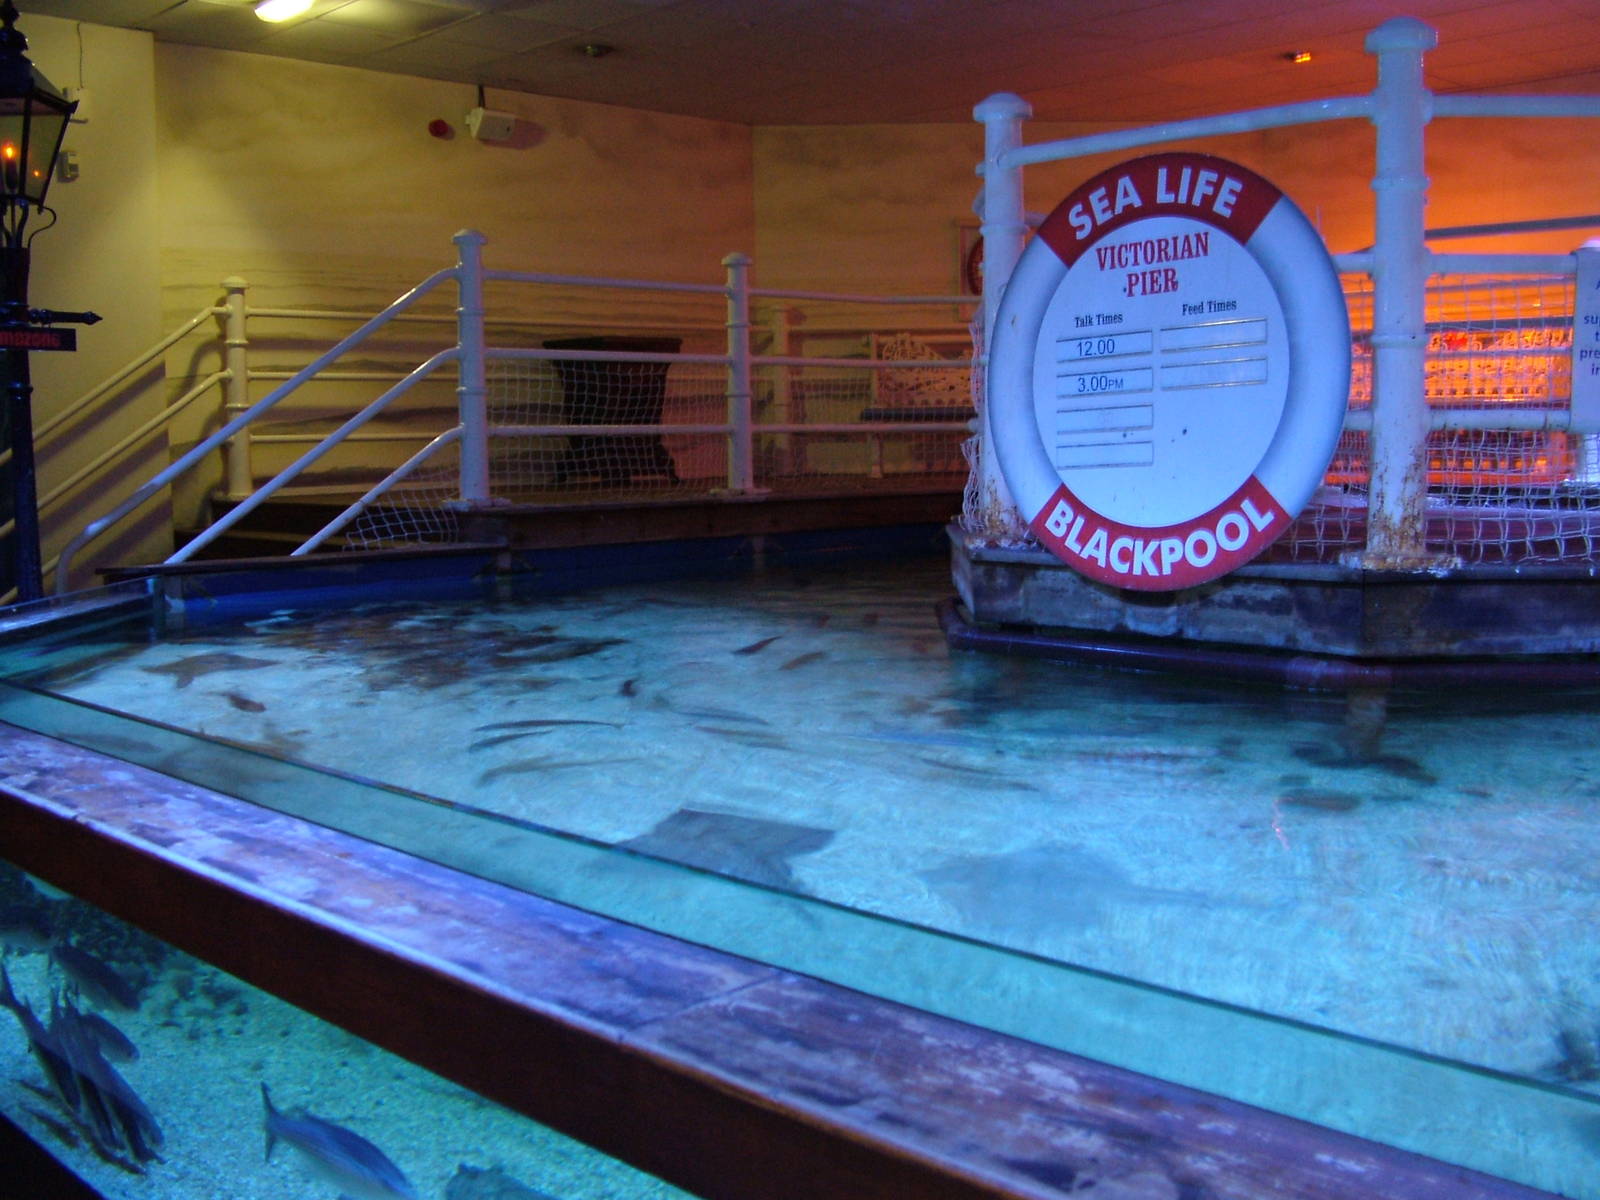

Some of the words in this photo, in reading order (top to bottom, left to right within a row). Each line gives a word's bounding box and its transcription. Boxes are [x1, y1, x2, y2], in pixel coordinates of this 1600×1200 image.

[1067, 174, 1143, 241] SEA
[1155, 166, 1244, 219] LIFE
[1096, 231, 1210, 272] VICTORIAN
[1126, 268, 1179, 298] PIER
[1075, 314, 1094, 329] Talk
[1096, 312, 1124, 326] Times
[1182, 302, 1204, 316] Feed
[1207, 299, 1238, 314] Times
[1077, 338, 1116, 357] 12.00
[1043, 496, 1276, 577] BLACKPOOL
